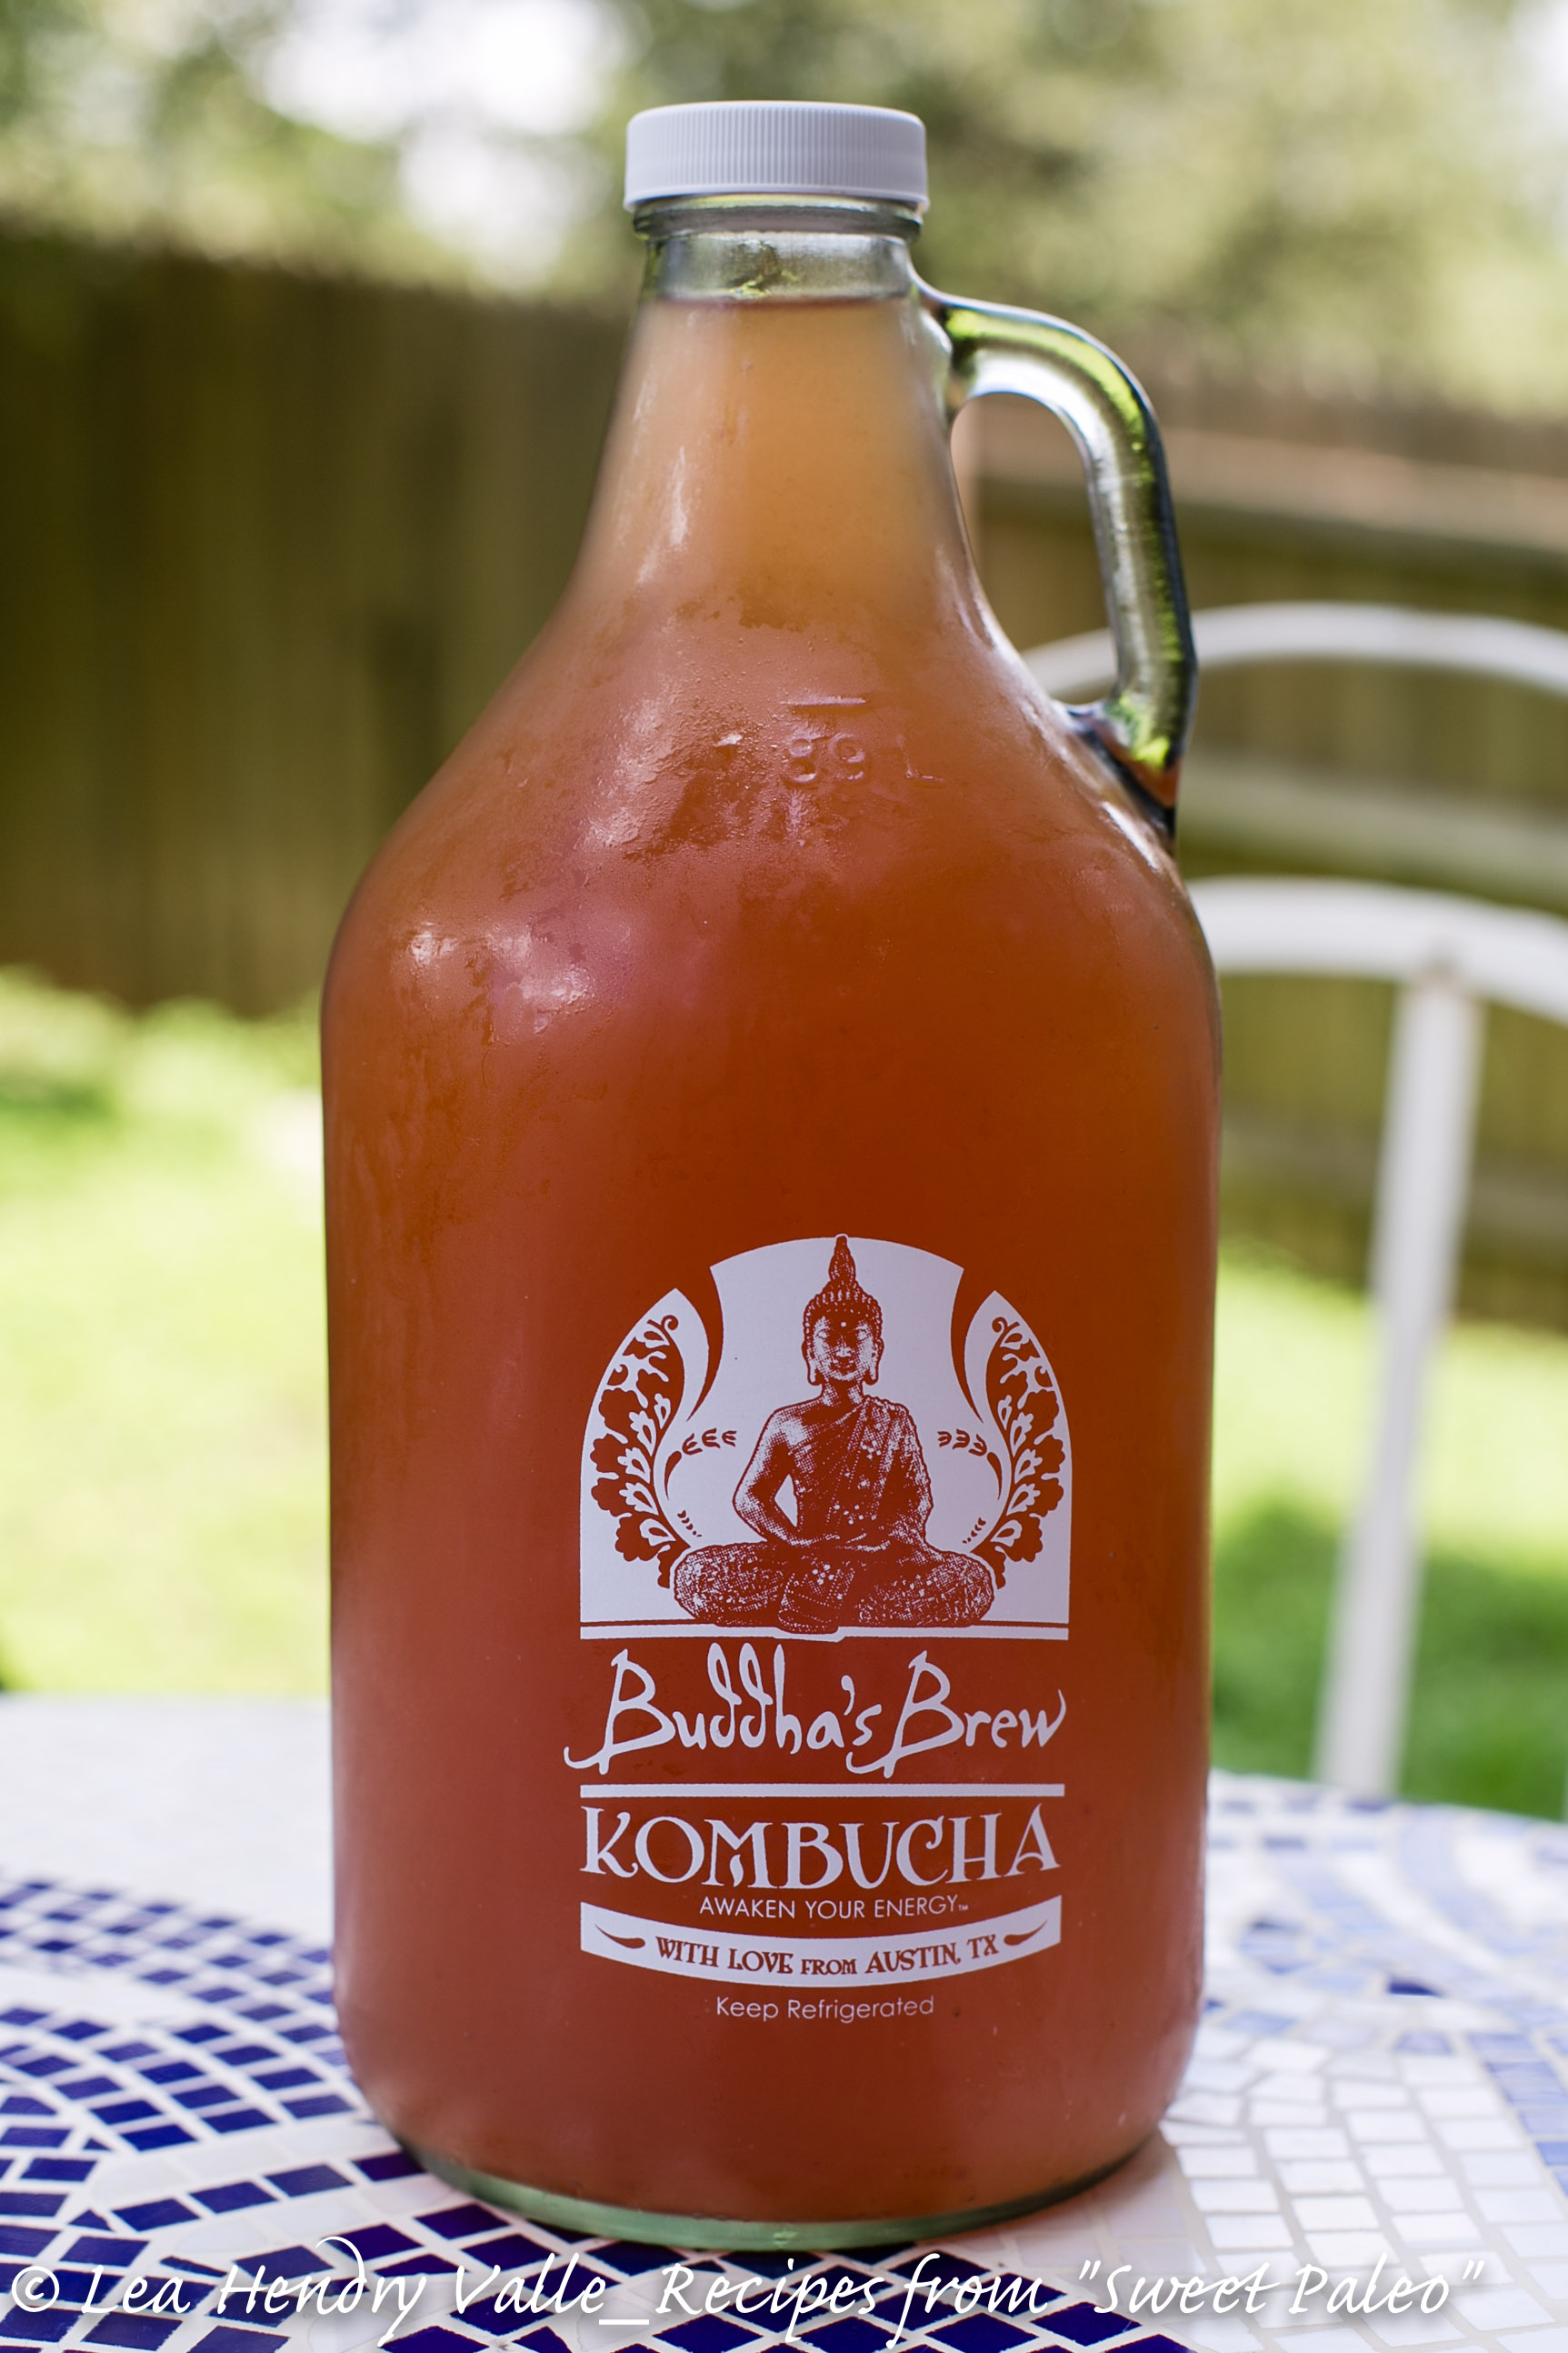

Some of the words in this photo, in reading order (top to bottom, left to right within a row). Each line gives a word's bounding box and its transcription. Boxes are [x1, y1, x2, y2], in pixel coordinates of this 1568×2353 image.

[563, 1643, 882, 1775] Buddha's
[845, 1650, 1066, 1778] Brew
[579, 1803, 1061, 1889] KOMBUCHA
[699, 1896, 796, 1919] AWAKEN
[805, 1897, 865, 1919] YOUR
[654, 1936, 719, 1968] WITH
[727, 1948, 794, 1975] LOVE
[800, 1957, 858, 1976] FROM
[864, 1942, 961, 1974] AUSTIN,
[966, 1933, 999, 1961] TX
[715, 1996, 779, 2023] Keep
[787, 1995, 934, 2023] Refrigerated
